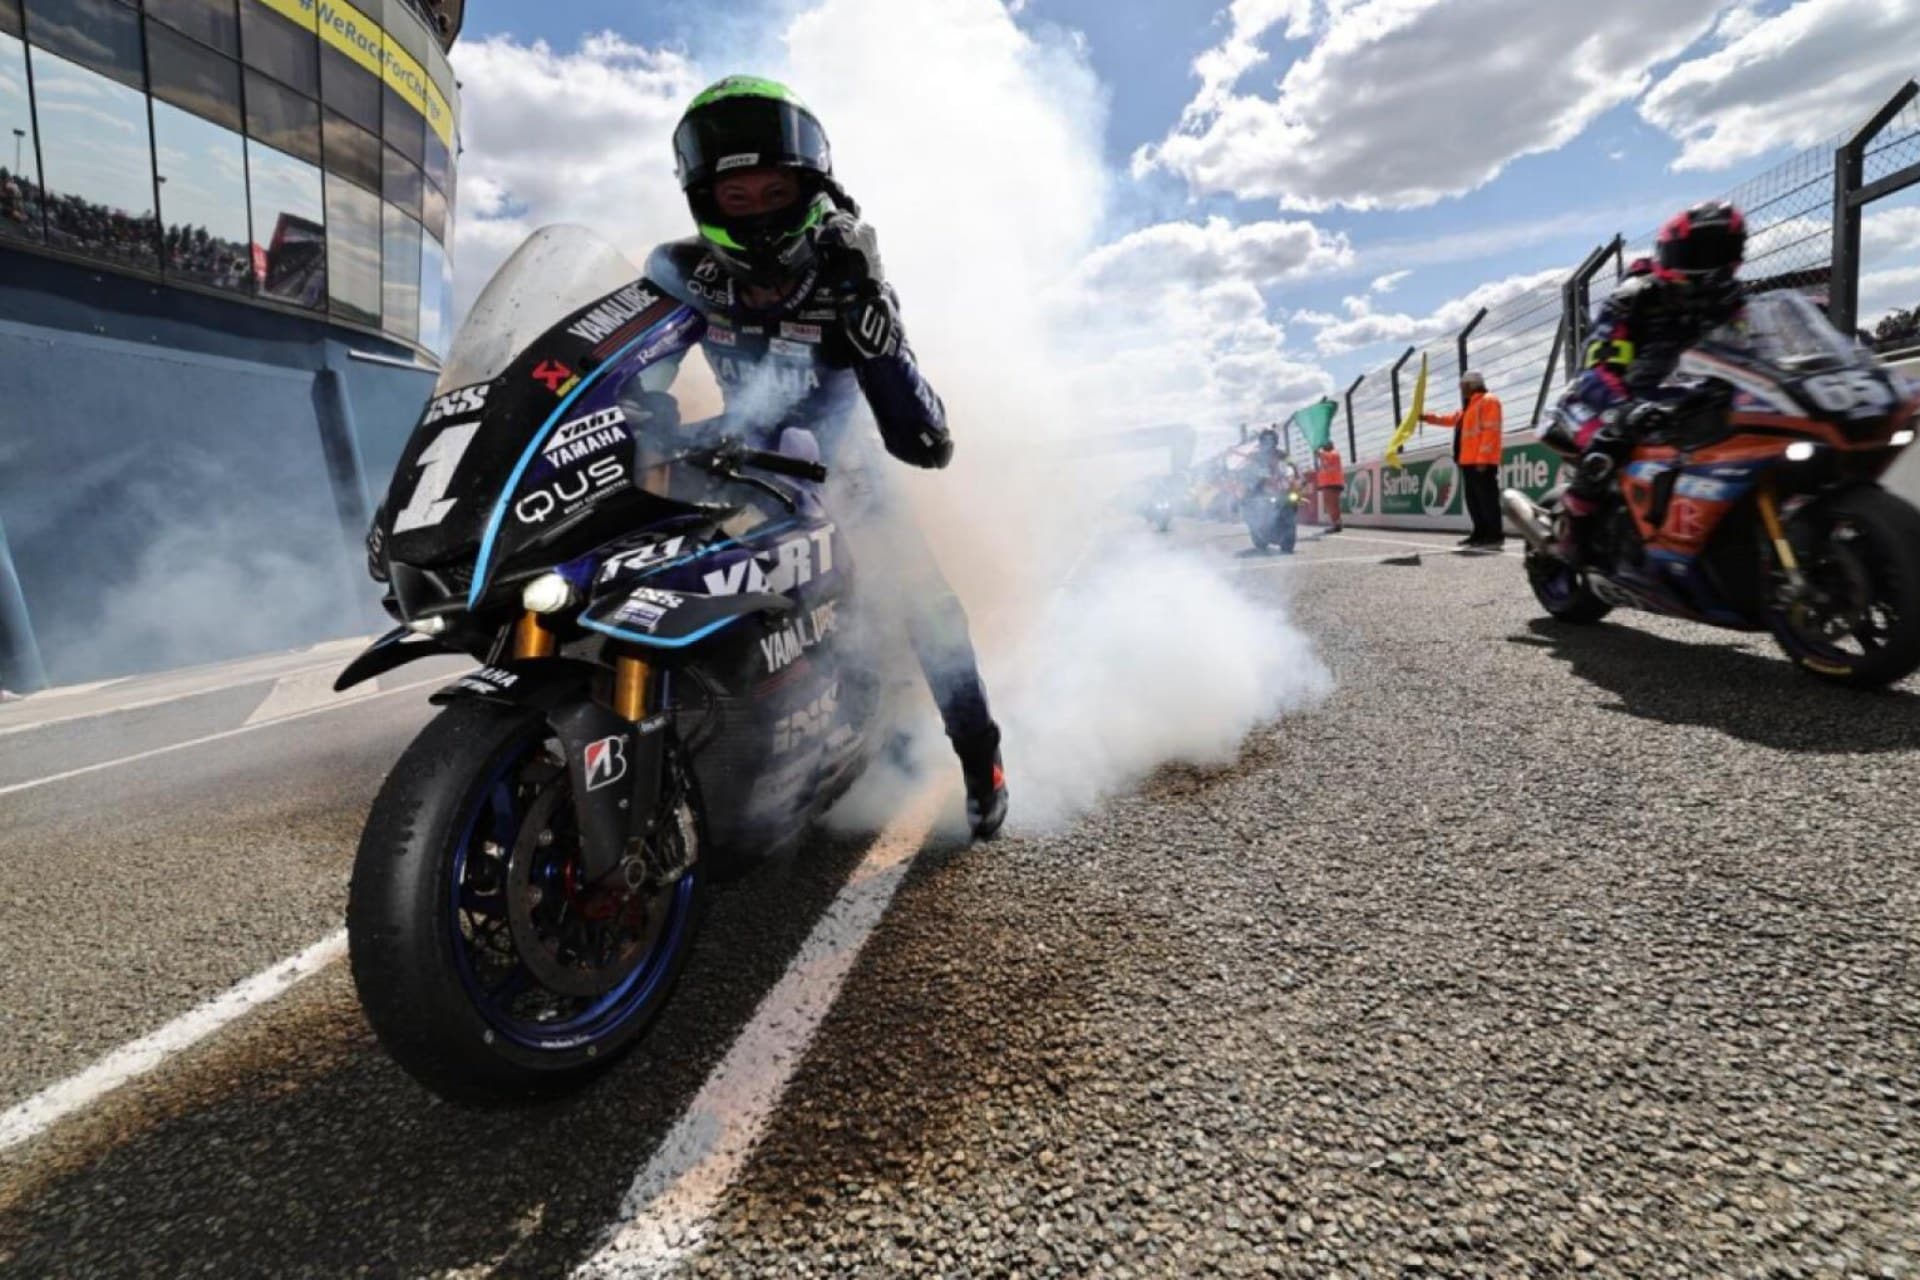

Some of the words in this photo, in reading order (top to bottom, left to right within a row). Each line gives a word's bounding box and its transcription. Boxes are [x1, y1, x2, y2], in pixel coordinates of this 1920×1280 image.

[567, 282, 659, 344] YAMALUBE
[546, 425, 627, 468] YAMAHA
[1497, 452, 1549, 490] rthe
[392, 422, 482, 535] 1
[516, 455, 624, 523] QUS
[1383, 468, 1419, 496] Sarthe
